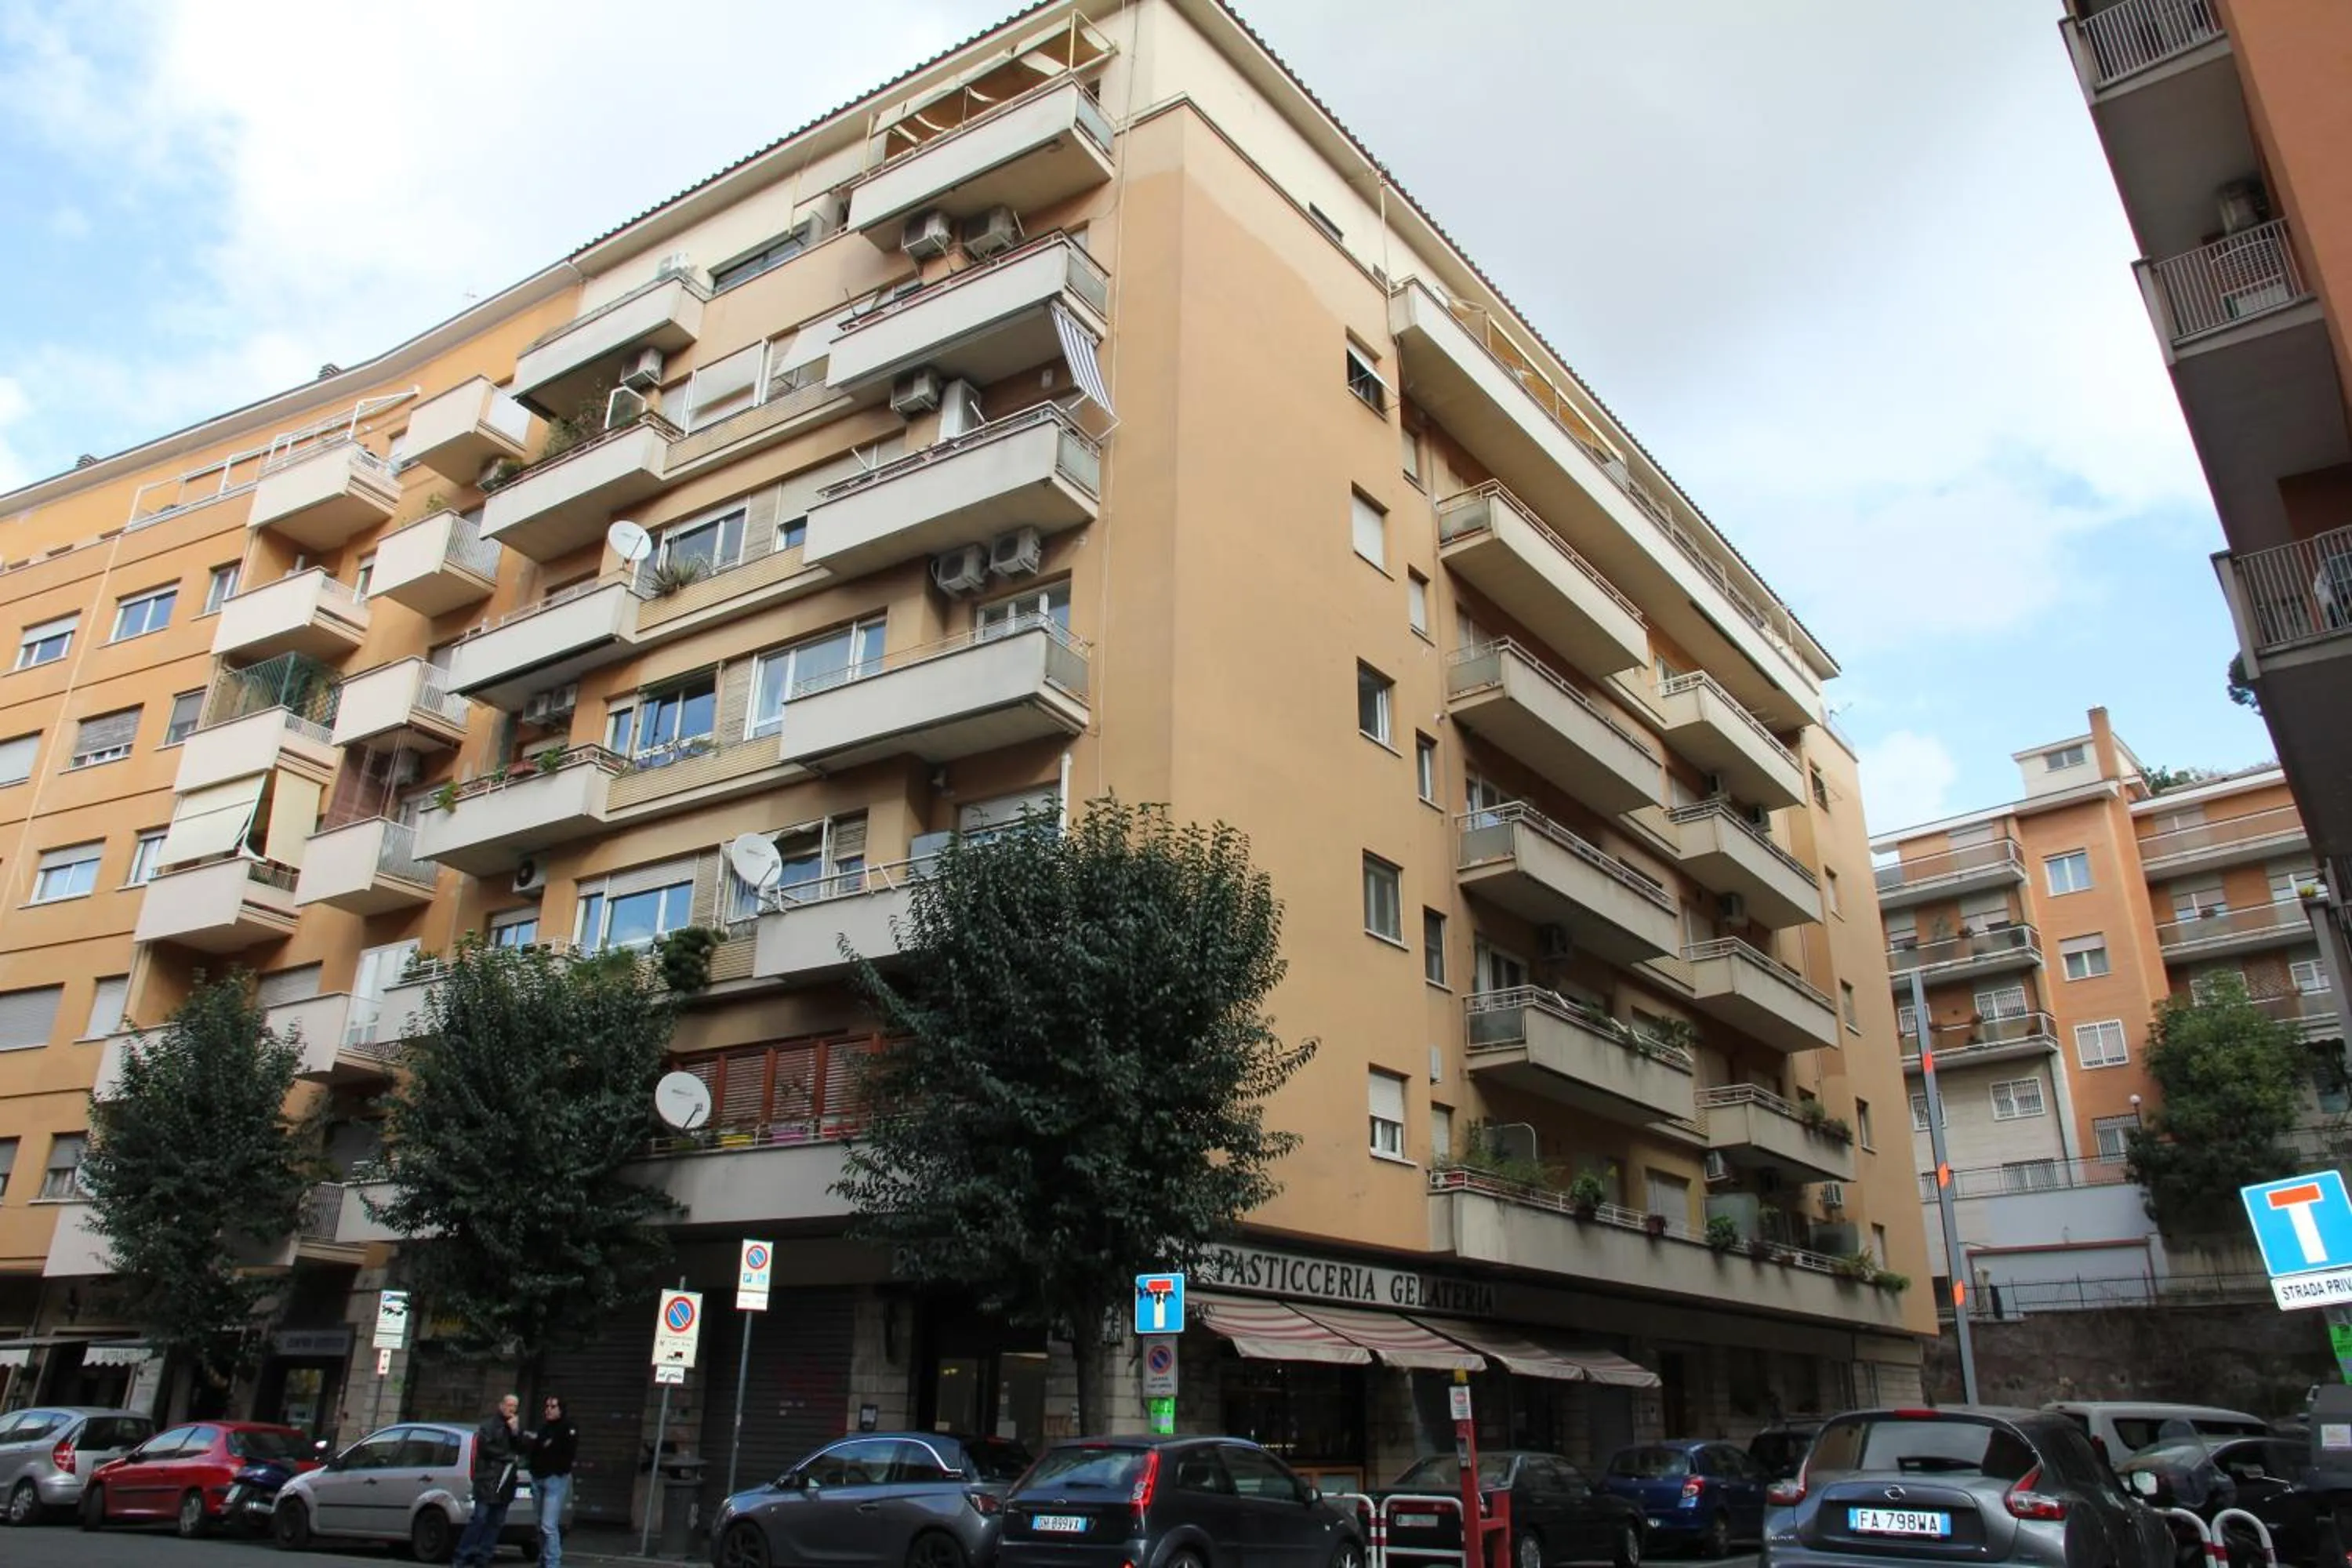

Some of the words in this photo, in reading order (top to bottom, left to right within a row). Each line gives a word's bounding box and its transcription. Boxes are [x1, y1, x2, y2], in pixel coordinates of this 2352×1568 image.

[1216, 1248, 1376, 1301] PASTICCERIA
[1390, 1274, 1494, 1314] GELATERIA
[2281, 1281, 2325, 1301] STRADA
